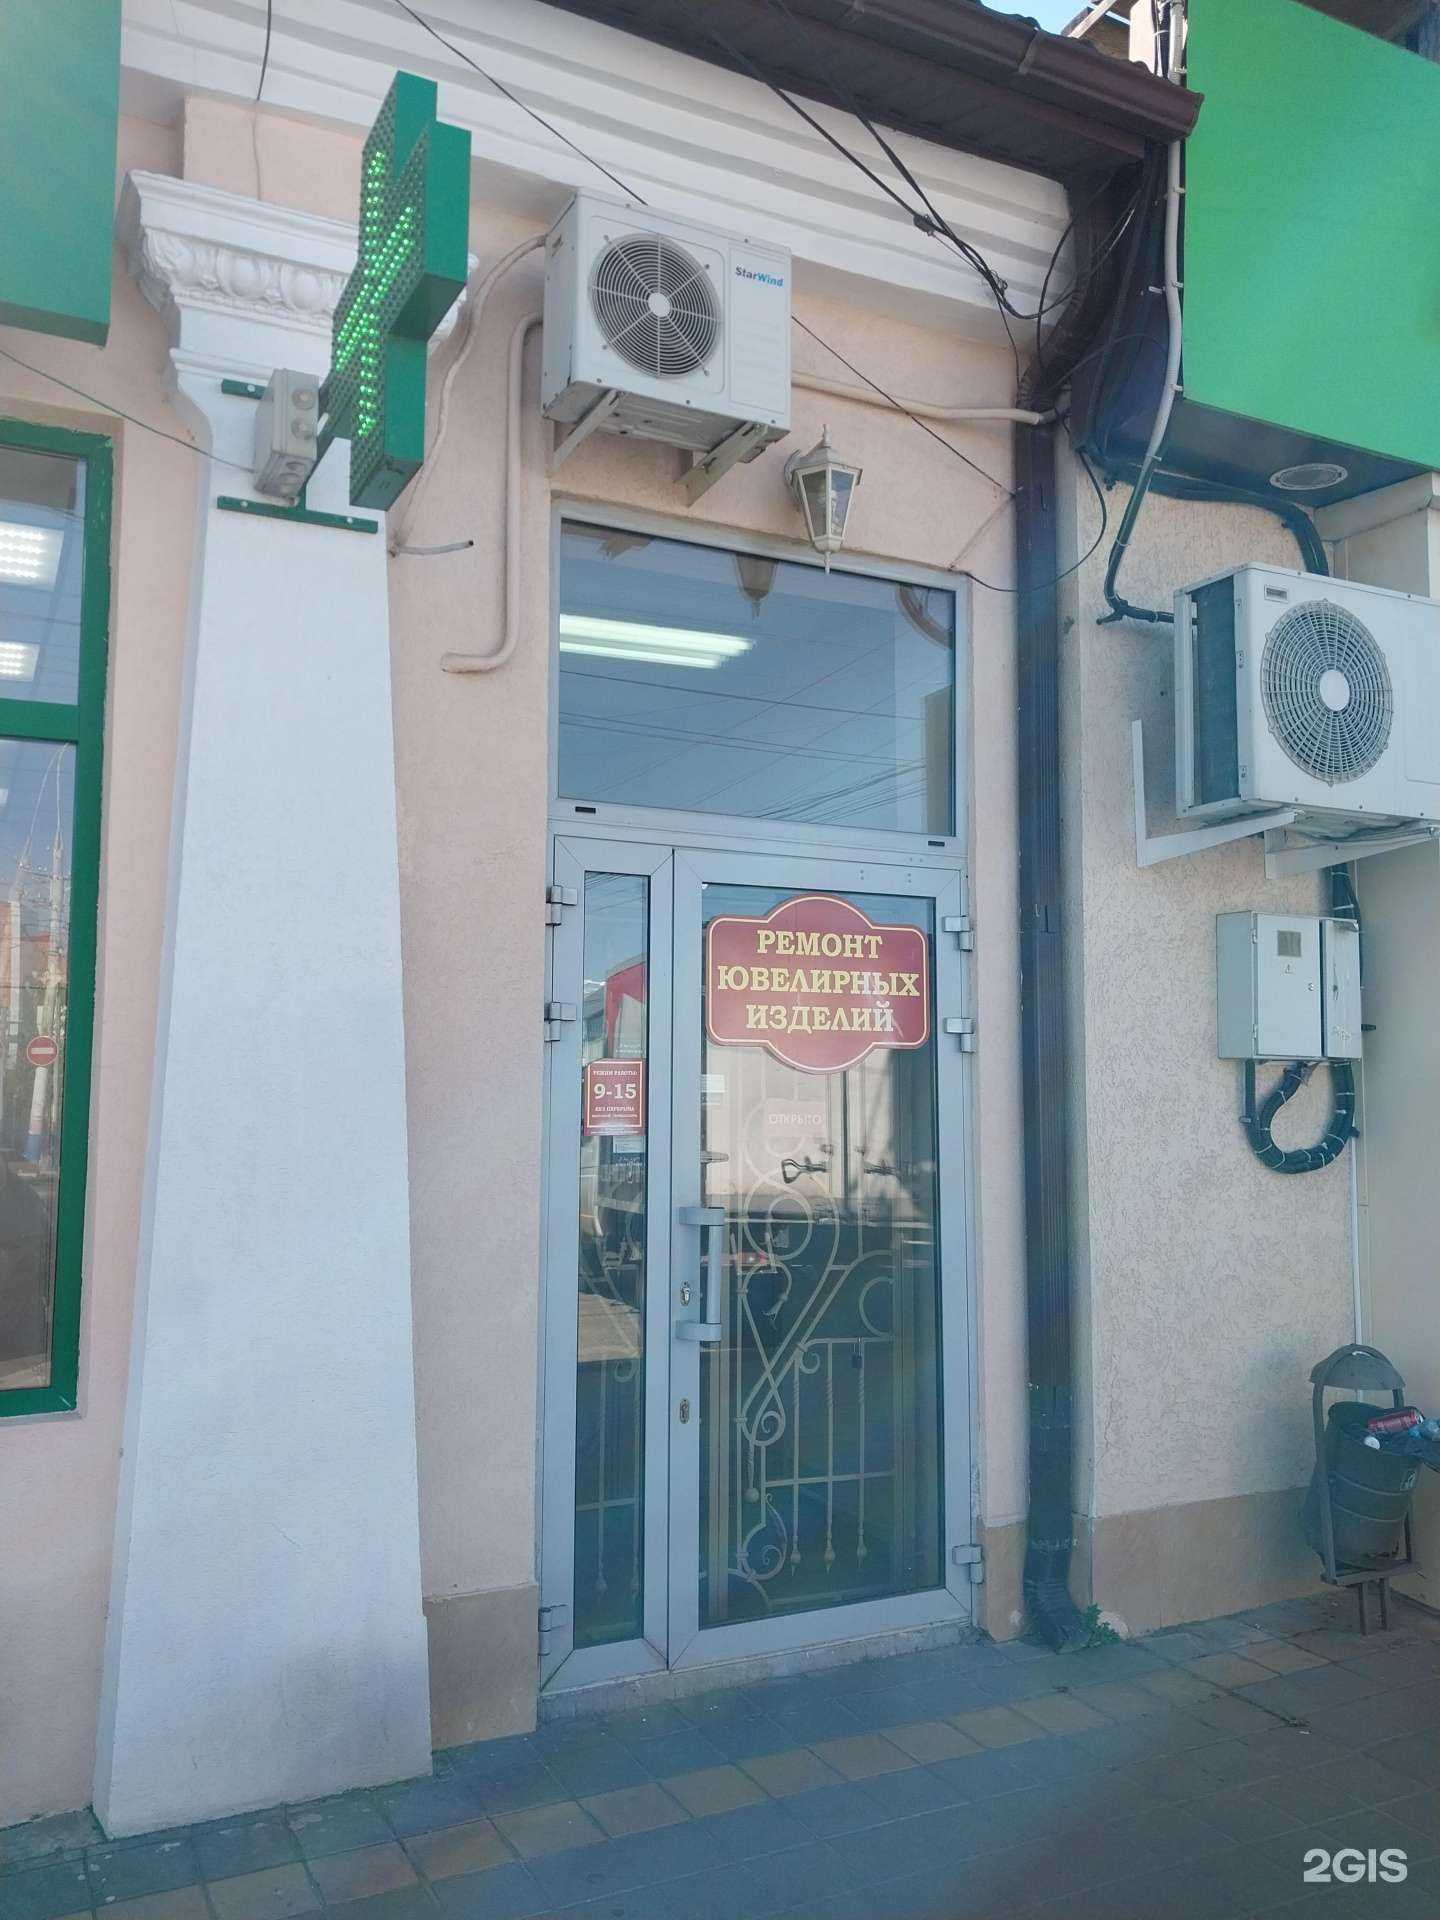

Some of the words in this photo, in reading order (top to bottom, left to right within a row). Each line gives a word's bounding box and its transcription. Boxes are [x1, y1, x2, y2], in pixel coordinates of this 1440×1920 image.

[735, 265, 784, 287] StarWind
[757, 929, 883, 959] РЕМОНТ
[717, 965, 921, 997] ЮВЕЛИРНЫХ
[746, 1000, 894, 1034] ИЗДЕЛИЙ
[593, 1083, 637, 1099] 9-15
